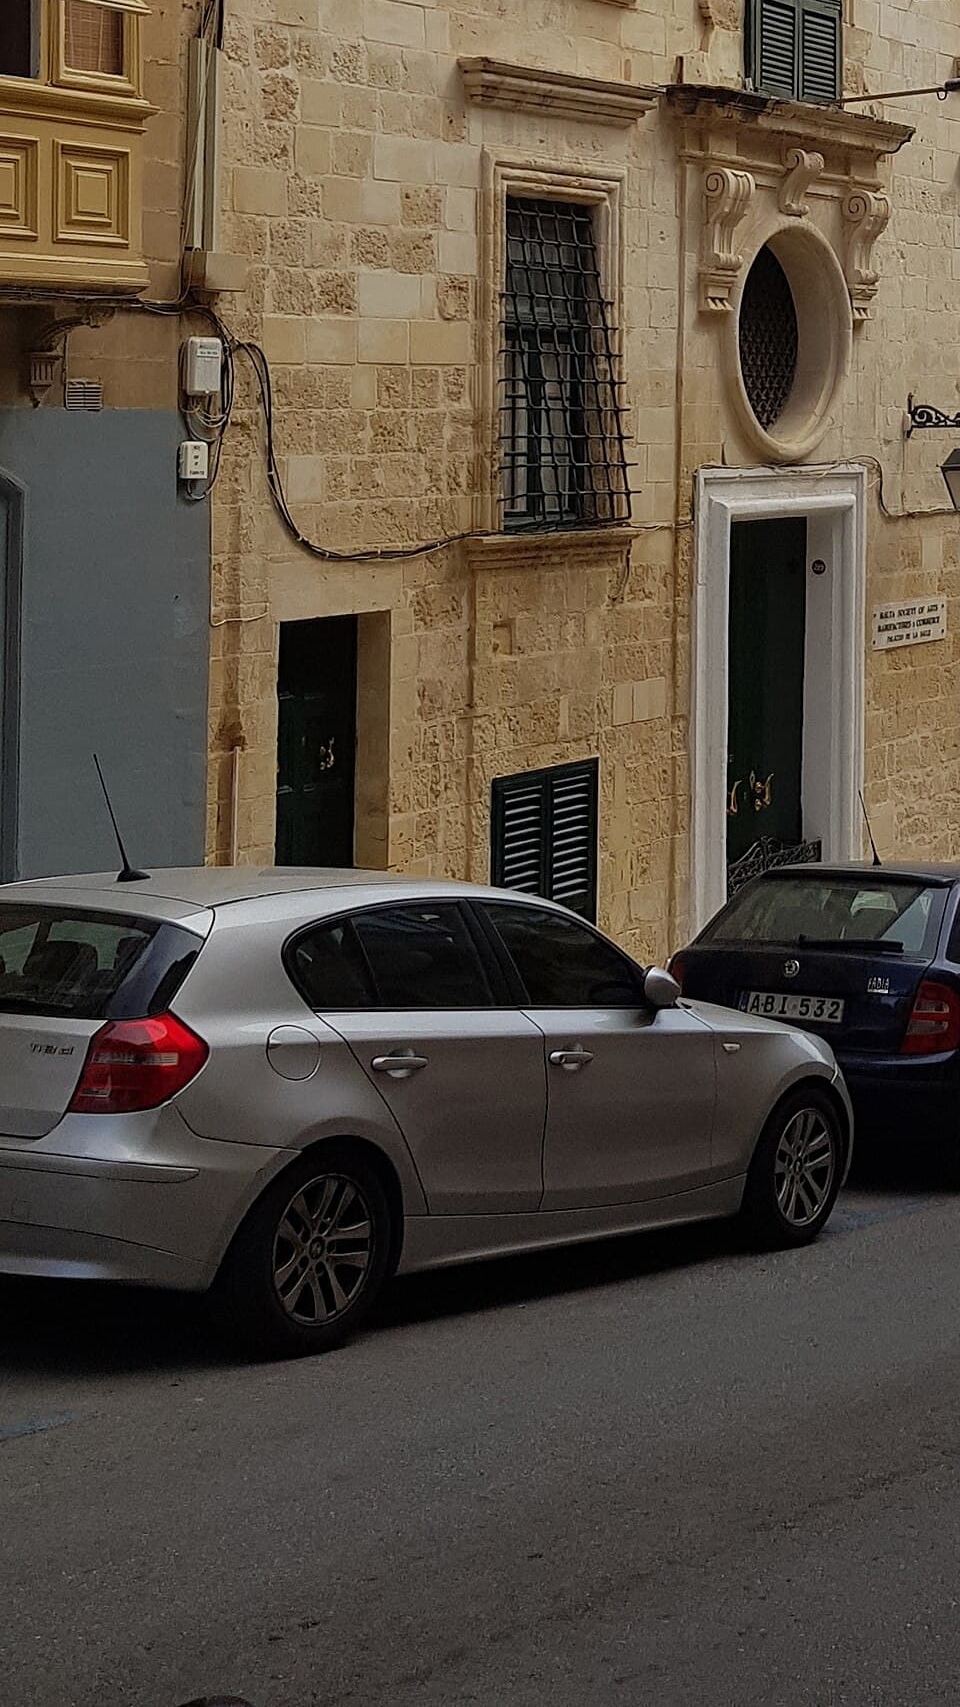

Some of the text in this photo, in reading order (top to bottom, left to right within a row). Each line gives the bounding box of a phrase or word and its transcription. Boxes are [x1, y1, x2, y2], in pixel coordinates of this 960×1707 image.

[879, 610, 895, 619] MALTA
[897, 607, 917, 618] SOCIETY
[918, 604, 925, 615] OF
[867, 977, 890, 989] FABIA
[749, 994, 841, 1020] ABI 532
